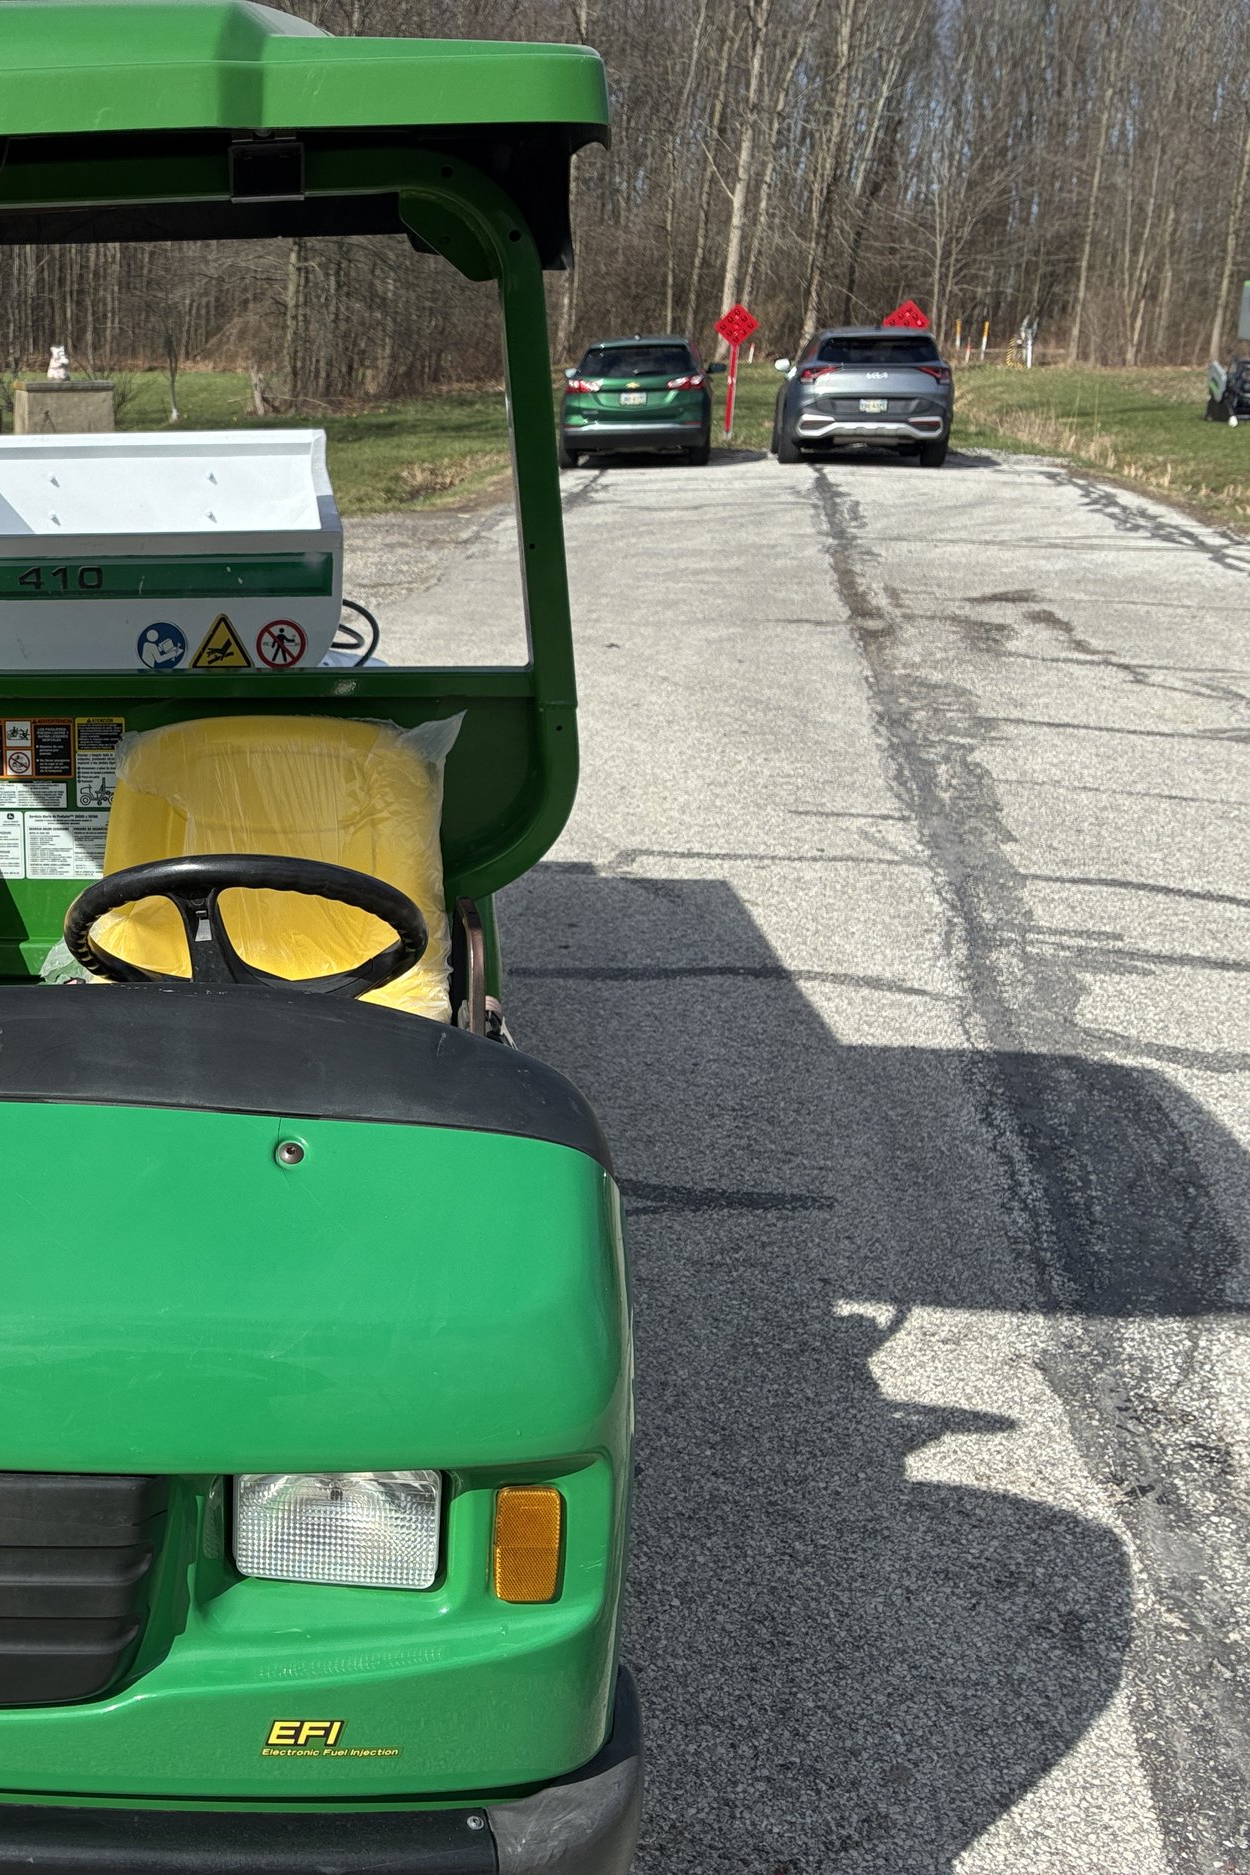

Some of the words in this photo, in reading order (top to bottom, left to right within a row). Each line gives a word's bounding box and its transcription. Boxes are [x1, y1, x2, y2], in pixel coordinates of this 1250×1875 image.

[18, 566, 104, 590] 410
[266, 1720, 344, 1746] EFI
[262, 1749, 319, 1757] Electronic
[323, 1749, 347, 1757] Fuel
[350, 1749, 399, 1758] Injection
